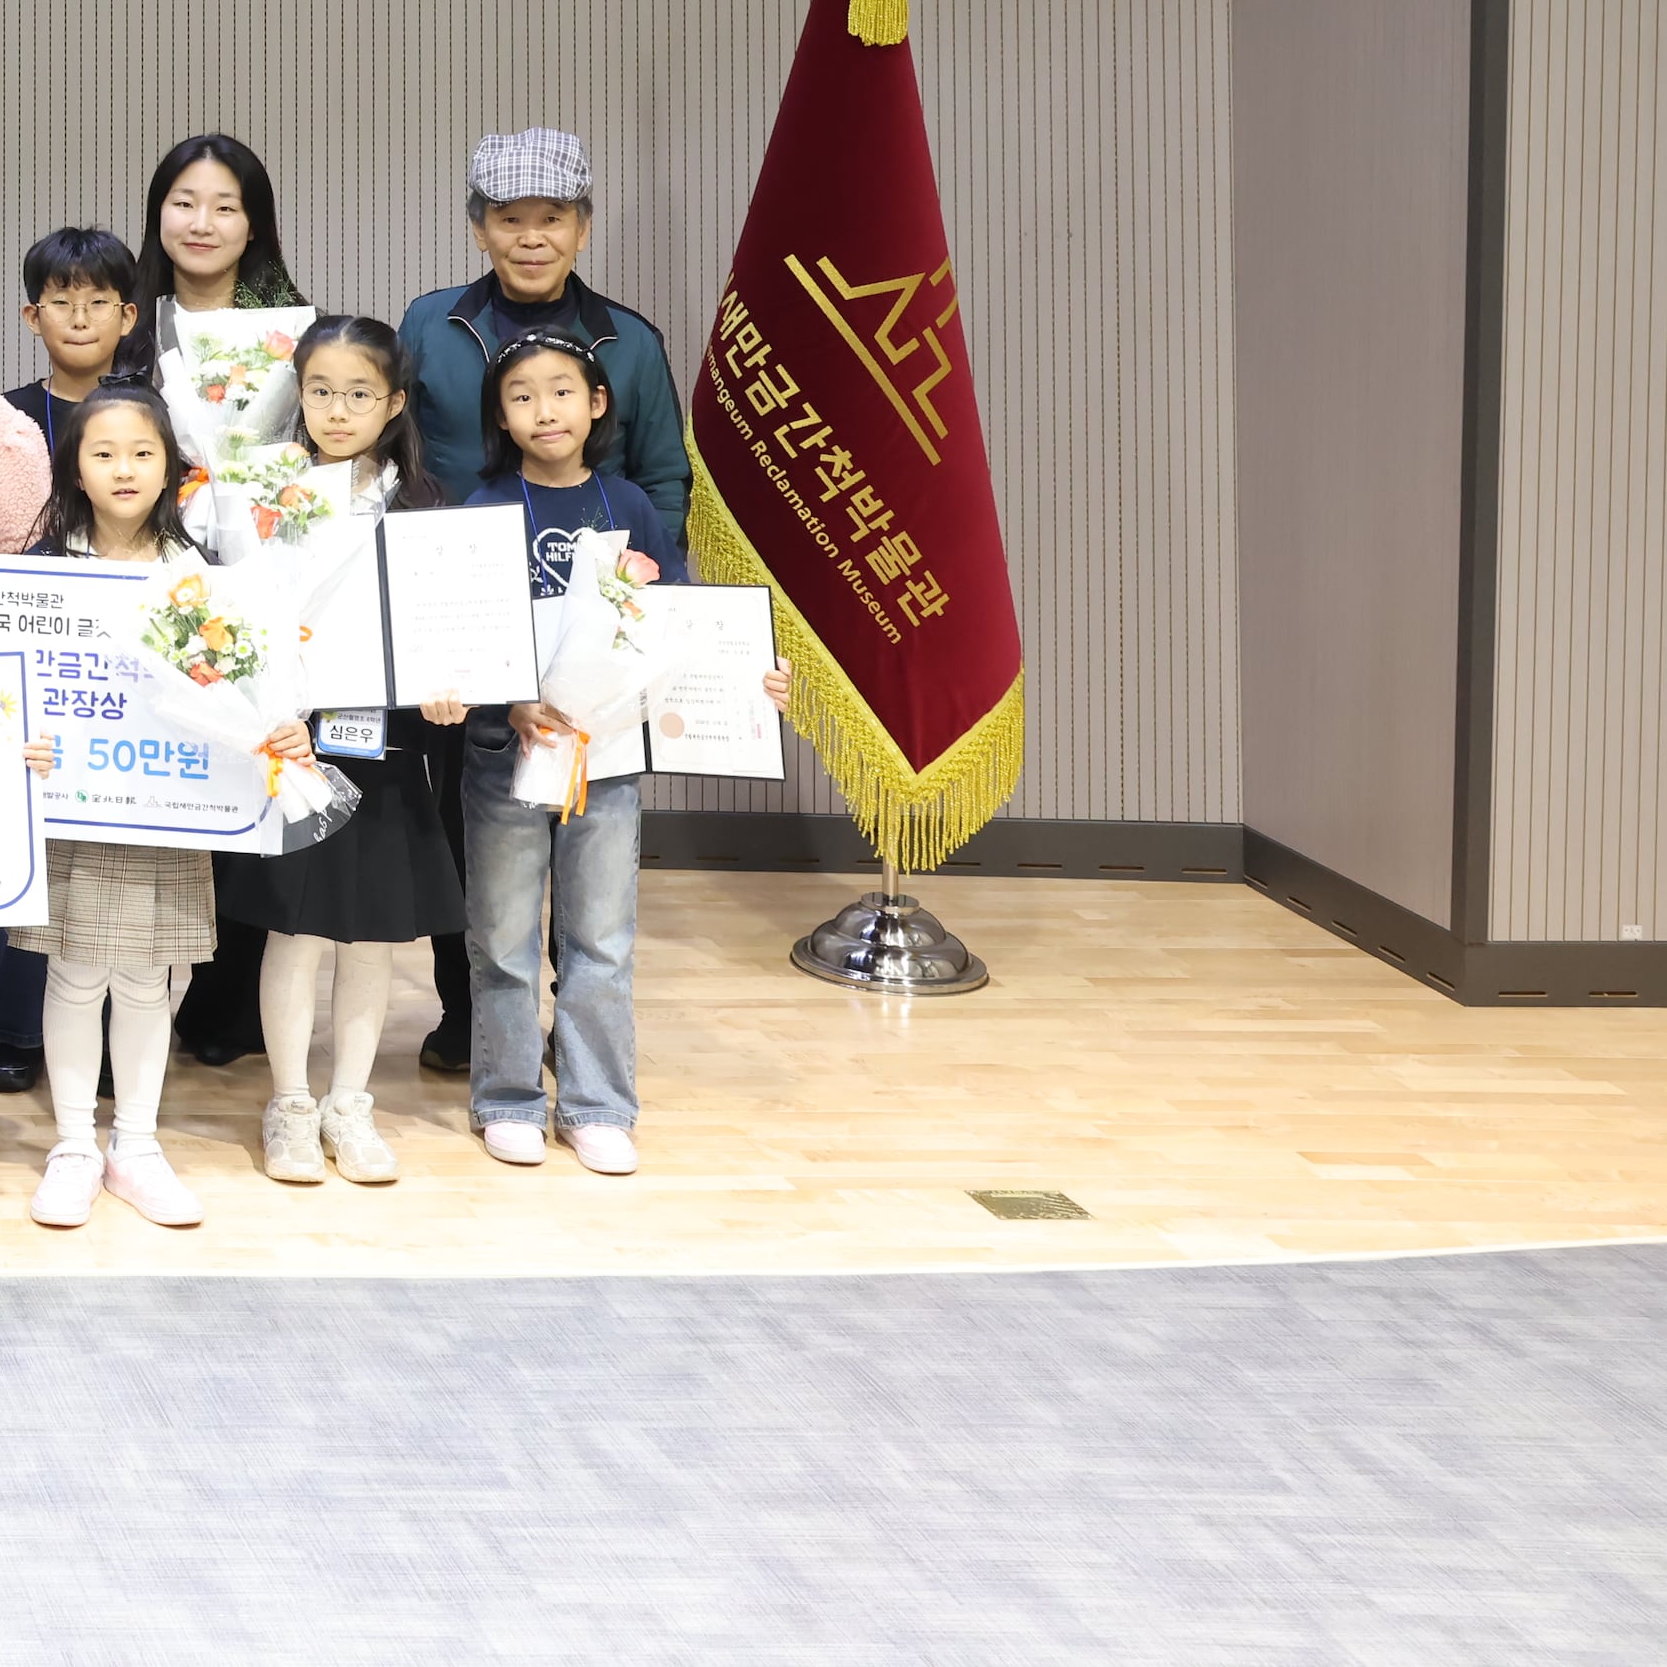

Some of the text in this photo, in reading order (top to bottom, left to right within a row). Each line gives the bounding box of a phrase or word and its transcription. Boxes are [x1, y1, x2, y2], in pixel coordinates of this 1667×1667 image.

[720, 271, 953, 628] 새만금간척박물관
[547, 542, 577, 552] TOM
[750, 439, 839, 559] Reclamation
[836, 558, 903, 645] Museum
[546, 552, 574, 562] HILF
[18, 614, 70, 636] 어린이
[43, 687, 127, 720] 관장상
[330, 725, 373, 744] 심은우
[87, 738, 210, 780] 50만원
